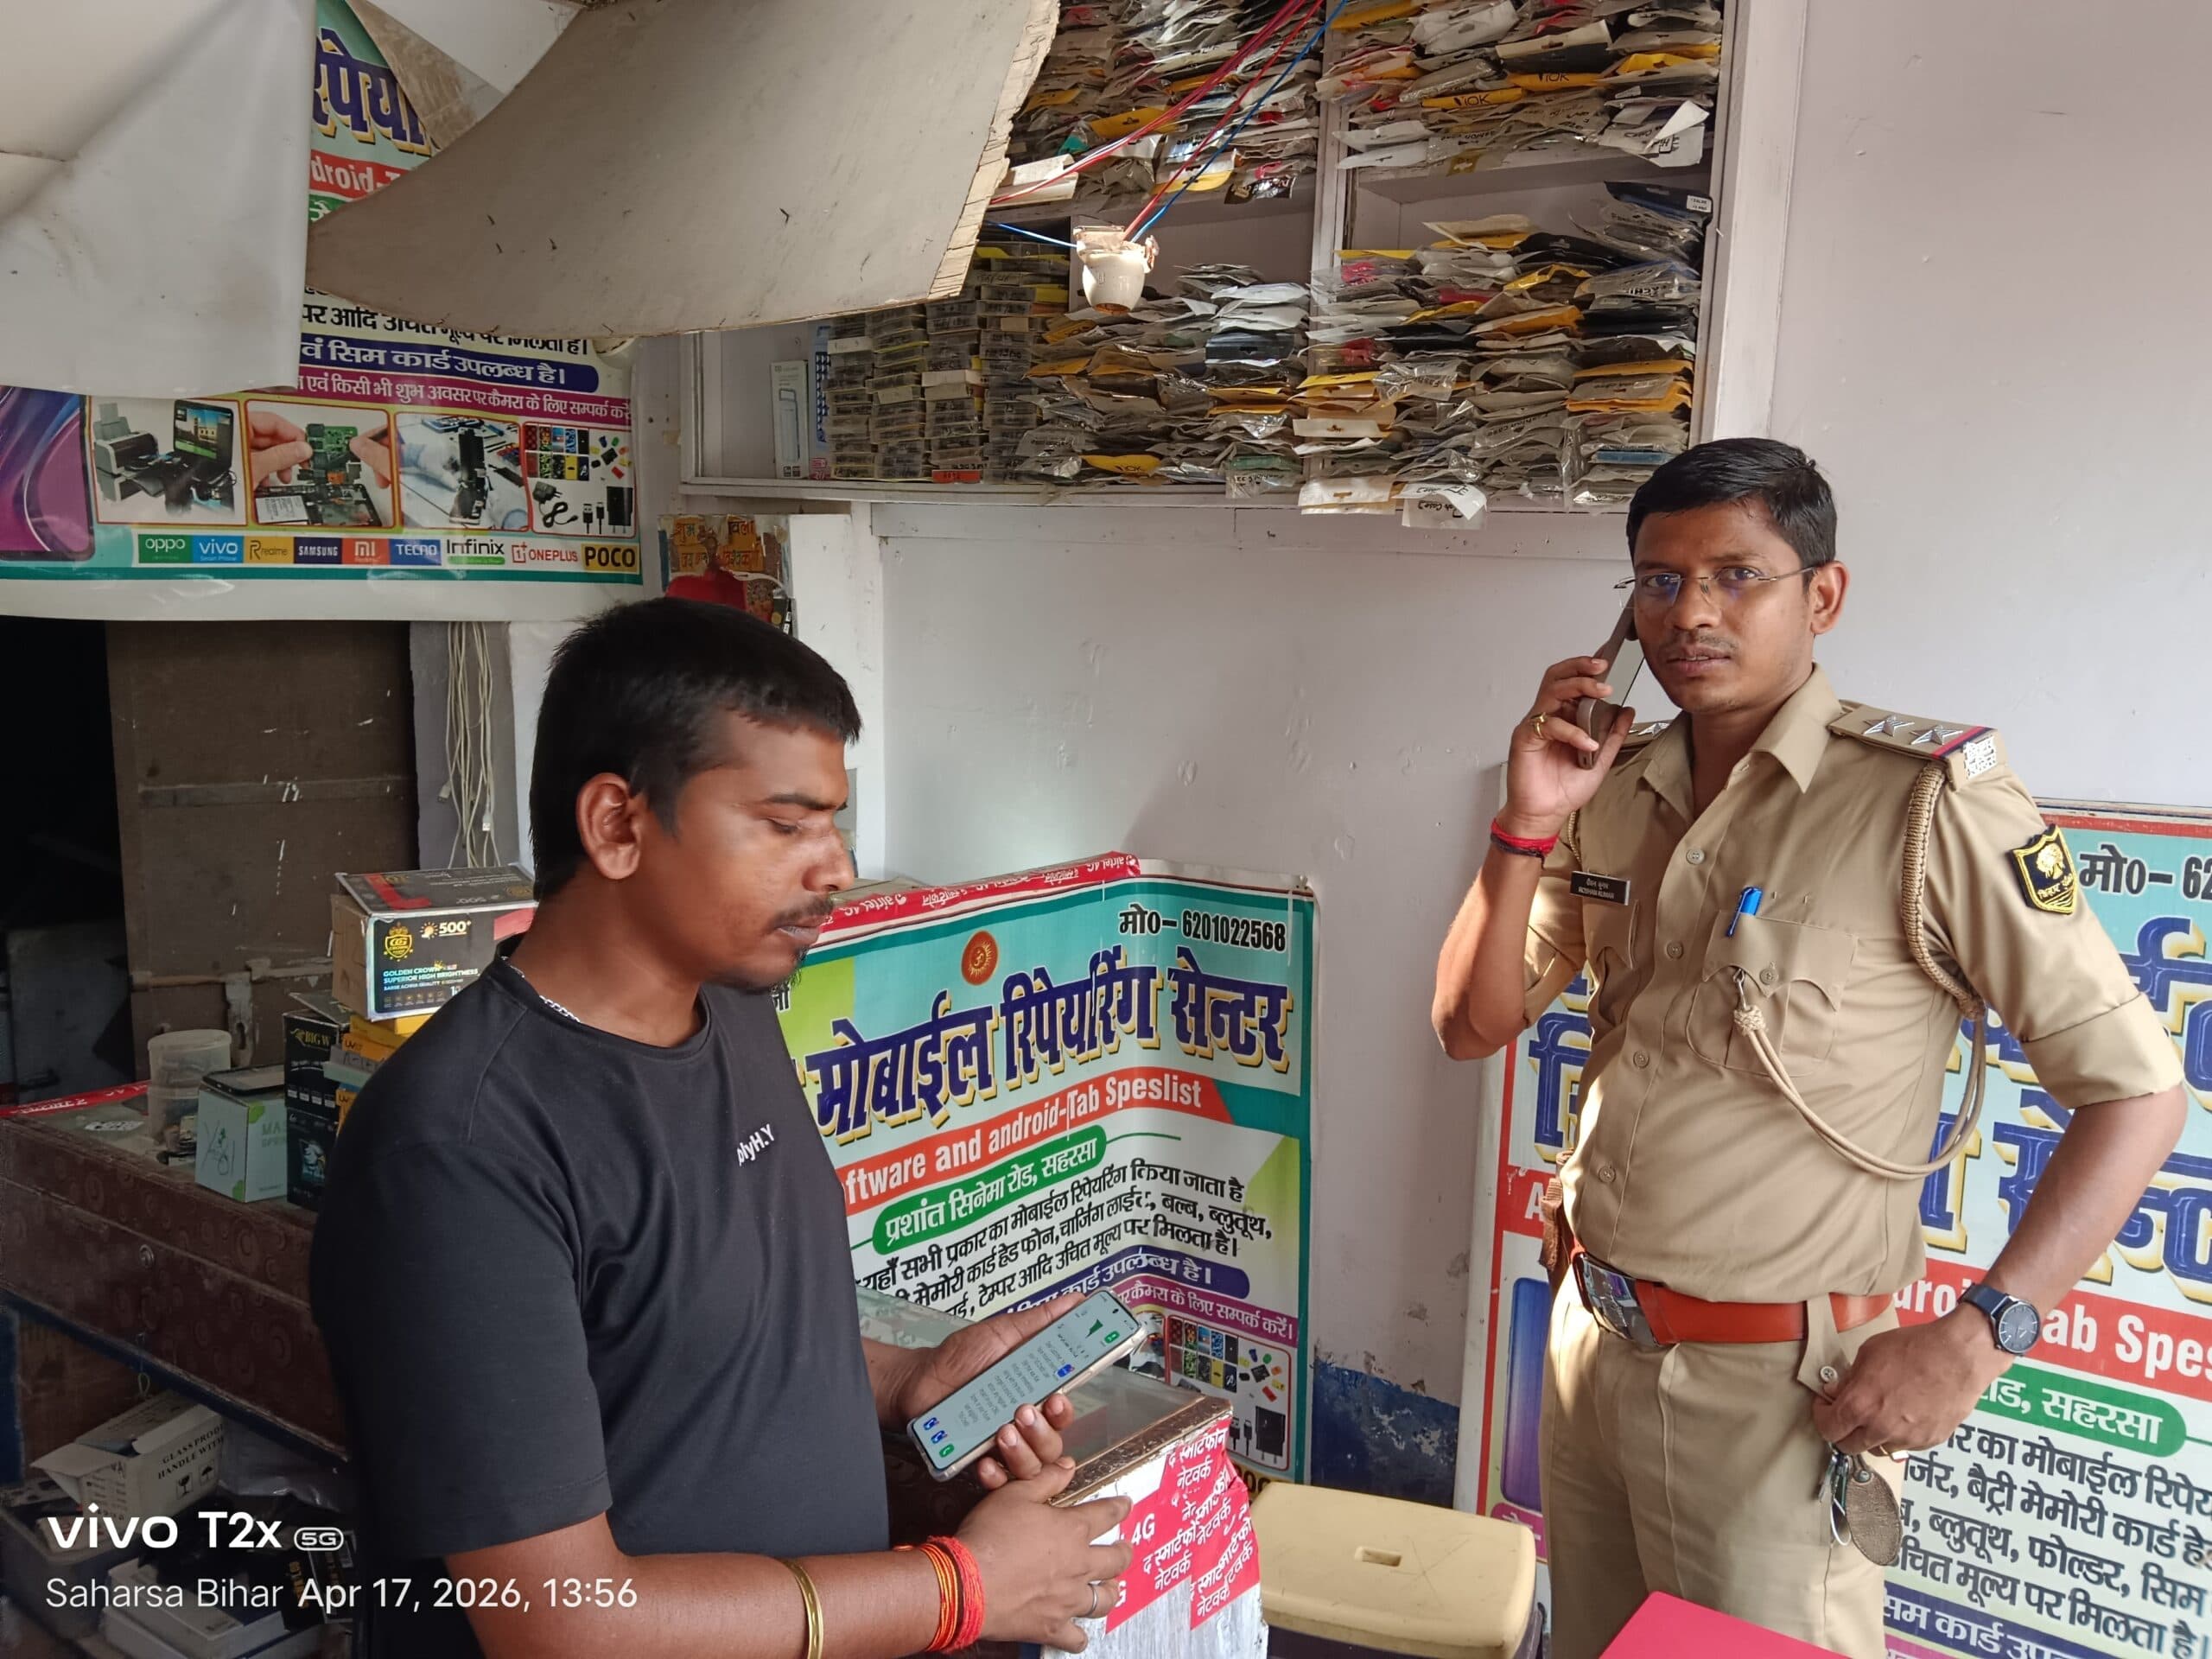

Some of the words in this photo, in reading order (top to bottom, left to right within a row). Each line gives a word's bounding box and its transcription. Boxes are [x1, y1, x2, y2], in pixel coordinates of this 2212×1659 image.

[327, 339, 388, 365] सिम
[391, 349, 452, 371] कार्ड
[451, 355, 534, 381] उपलब्ध
[537, 362, 566, 385] है।
[331, 372, 371, 396] किसी
[373, 377, 392, 397] भी
[396, 383, 425, 404] शुभ
[427, 385, 473, 403] अवसर
[526, 393, 540, 410] के
[543, 394, 568, 415] लिए
[569, 399, 609, 417] सम्पर्क
[145, 538, 186, 552] oppo
[199, 538, 238, 555] vivo
[298, 545, 338, 557] SAMSUNG
[446, 538, 505, 556] Infinix
[528, 549, 578, 563] ONEPLUS
[584, 546, 636, 568] POCO
[1183, 911, 1286, 951] 6201022568
[804, 990, 998, 1147] मोबाईल
[1000, 944, 1163, 1090] रिपेयरिंग
[1167, 945, 1294, 1075] सेन्टर
[845, 1152, 926, 1205] ftware
[935, 1129, 981, 1171] and
[1105, 1074, 1202, 1109] Speslist
[885, 1198, 947, 1247] प्रशांत
[949, 1178, 1007, 1223] सिनेमा
[1007, 1162, 1038, 1194] रोड,
[1040, 1137, 1097, 1179] सहरसा
[900, 1243, 943, 1280] सभी
[945, 1225, 988, 1268] प्रकार
[988, 1216, 1009, 1242] का
[1010, 1189, 1070, 1230] मोबाईल
[1071, 1163, 1128, 1206] रिपेयरिंग
[1129, 1158, 1181, 1185] किया
[1183, 1170, 1226, 1198] जाता
[1228, 1176, 1245, 1203] है
[967, 1245, 998, 1283] कार्ड
[998, 1243, 1020, 1268] हेड
[1020, 1225, 1060, 1256] फोन,
[1160, 1192, 1205, 1223] बल्ब,
[1018, 1253, 1053, 1289] आदि
[1055, 1237, 1091, 1270] उचित
[1093, 1222, 1122, 1255] मूल्य
[1123, 1218, 1152, 1236] पर
[1153, 1214, 1212, 1250] मिलता
[1215, 1230, 1238, 1257] है।
[1102, 1252, 1179, 1284] उपलब्ध
[1182, 1257, 1212, 1285] है।
[1131, 1279, 1168, 1303] कैमरा
[1171, 1287, 1185, 1306] के
[1189, 1294, 1214, 1317] लिए
[1216, 1302, 1261, 1329] सम्पर्क
[2042, 1387, 2163, 1445] सहरसा
[1177, 1455, 1213, 1489] नेटवर्क
[1977, 1429, 2018, 1465] का
[2022, 1435, 2143, 1498] मोबाईल
[1131, 1513, 1155, 1546] 4G
[1967, 1463, 2018, 1516] बैट्री
[2020, 1480, 2107, 1538] मेमोरी
[2113, 1512, 2181, 1559] कार्ड
[1154, 1549, 1192, 1591] नेटवर्क
[2028, 1534, 2131, 1599] फोल्डर,
[2140, 1561, 2209, 1618] सिम
[1955, 1560, 2020, 1609] मूल्य
[2024, 1580, 2067, 1621] पर
[2068, 1587, 2169, 1654] मिलता
[1935, 1611, 2005, 1655] कार्ड
